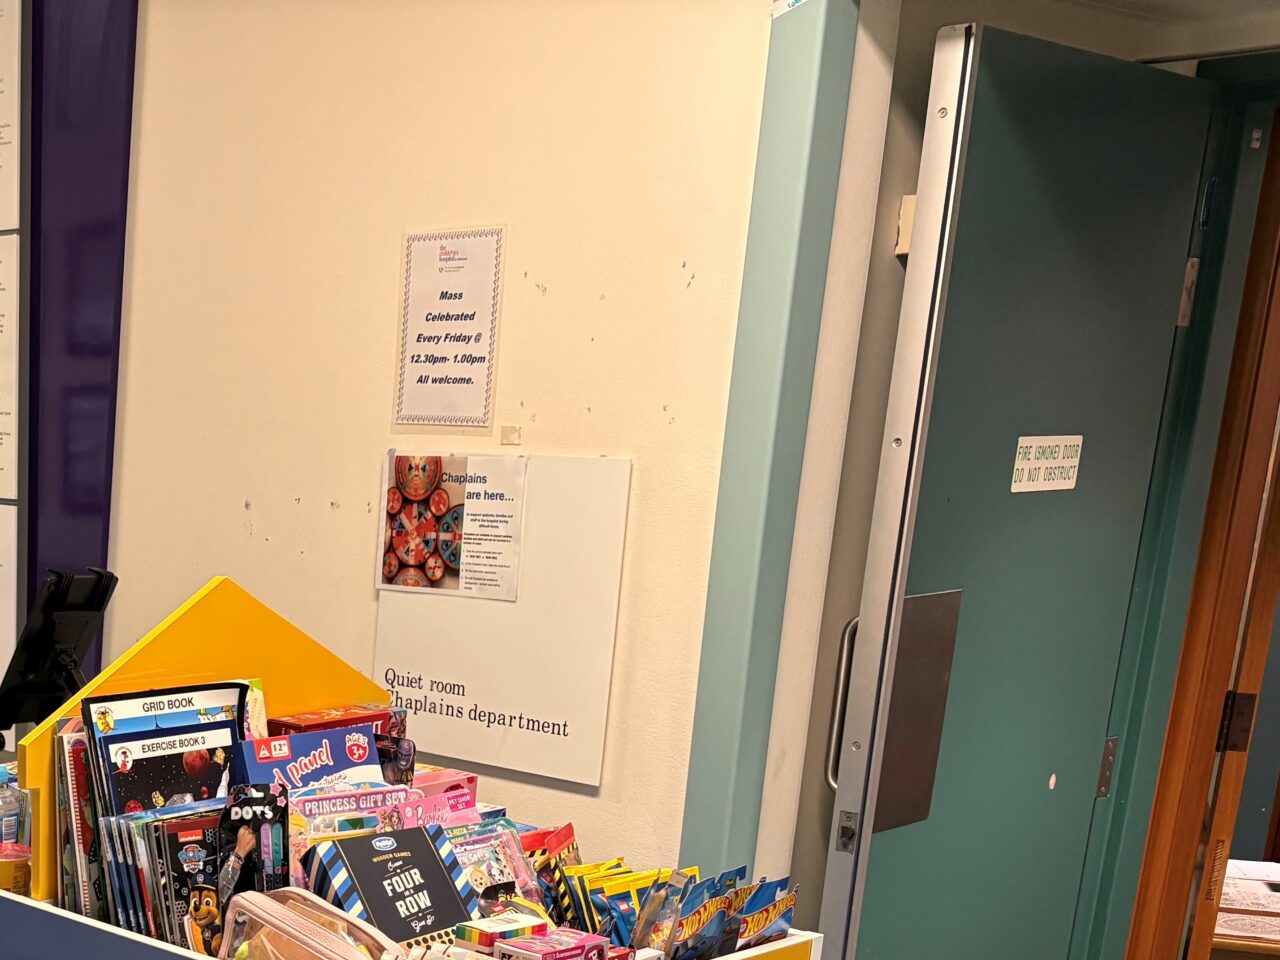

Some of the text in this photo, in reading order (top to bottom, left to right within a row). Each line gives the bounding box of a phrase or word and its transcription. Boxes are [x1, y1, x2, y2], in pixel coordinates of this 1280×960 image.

[439, 291, 464, 301] Mass
[425, 311, 476, 322] Celebrated
[416, 332, 483, 345] Every Friday @
[452, 354, 486, 366] 1.00pm
[416, 375, 475, 385] All welcome.
[1018, 444, 1080, 461] FIRE (SMOKE) DOOR
[440, 472, 487, 485] Chaplains
[1013, 465, 1077, 483] DO NOT OBSTRUCT
[466, 490, 514, 502] are here...
[384, 668, 466, 697] Quiet room
[142, 697, 195, 713] GRID BOOK
[468, 704, 569, 737] department
[142, 736, 206, 753] EXERCISE BOOK 3
[345, 733, 368, 746] AGES
[351, 745, 365, 760] 3+
[286, 738, 334, 787] panel
[304, 790, 408, 816] PRINCESS GIFT SET
[230, 805, 273, 820] DOTS
[414, 801, 450, 825] Barbie
[382, 868, 424, 897] FOUR
[395, 890, 432, 918] ROW
